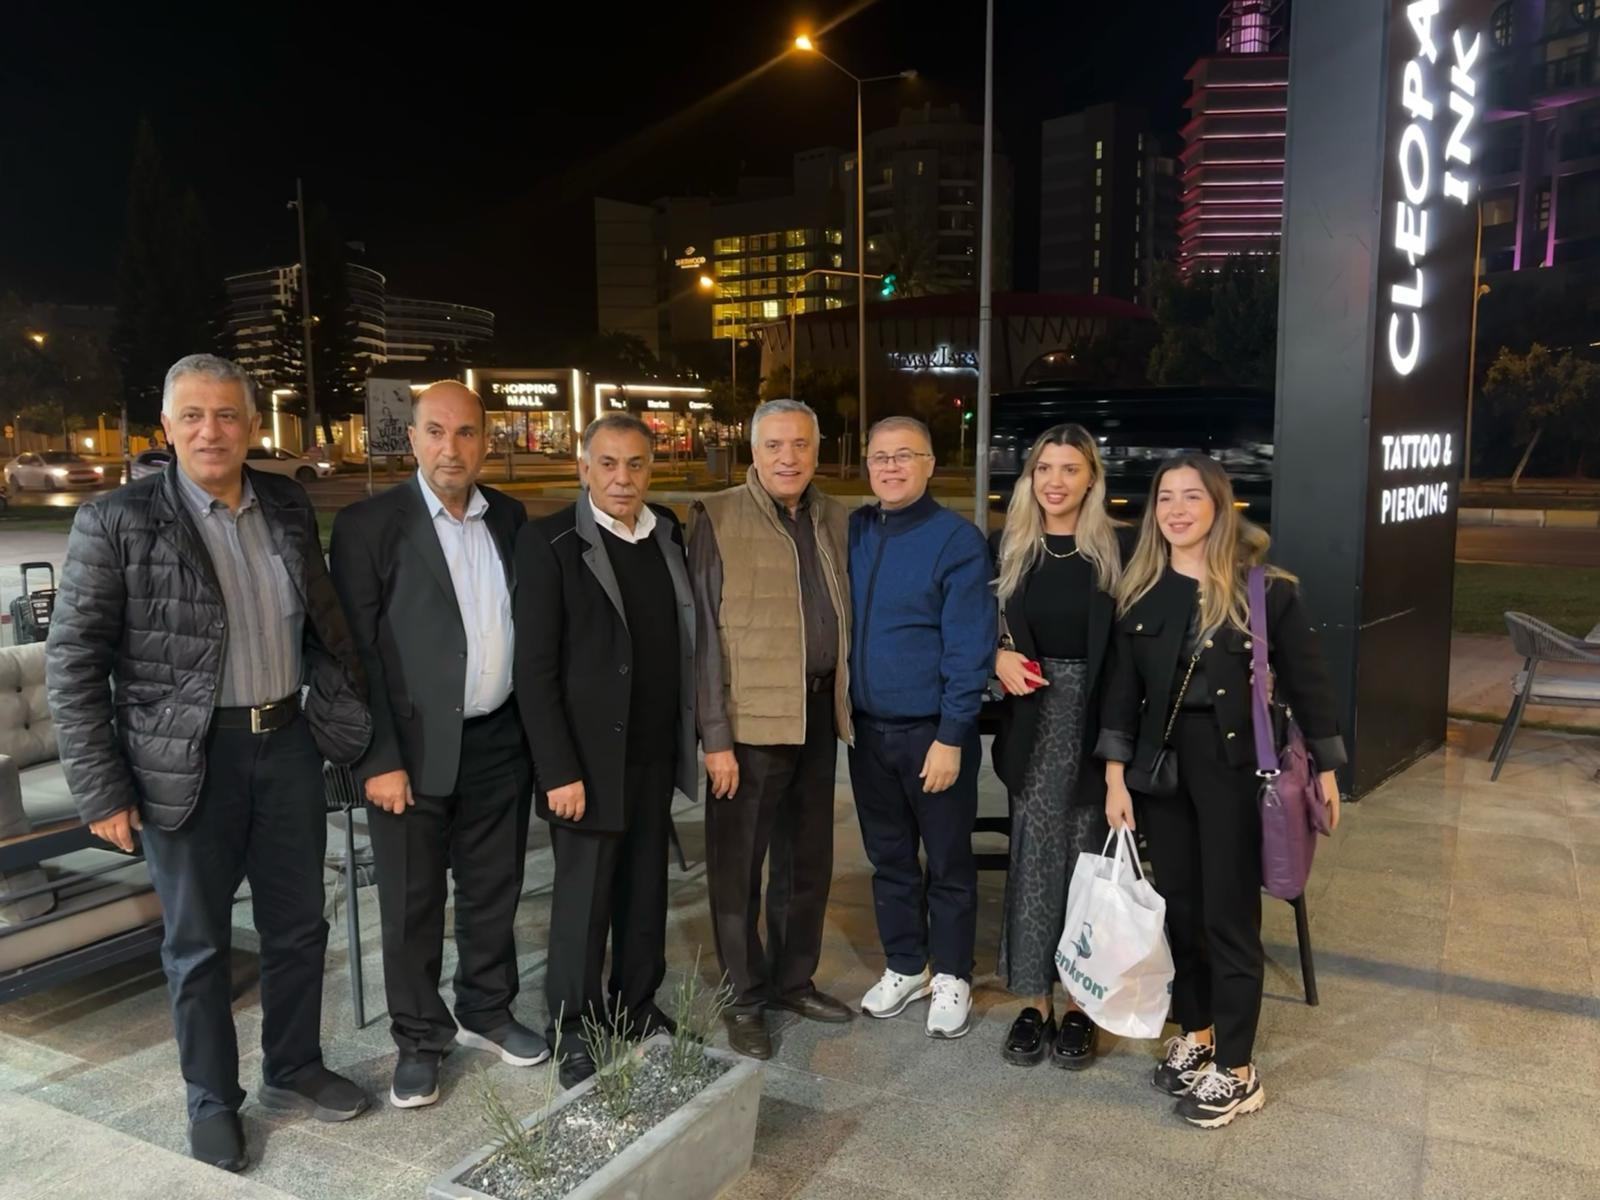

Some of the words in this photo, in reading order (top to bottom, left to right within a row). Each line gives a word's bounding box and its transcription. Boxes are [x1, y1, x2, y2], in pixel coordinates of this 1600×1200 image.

[1443, 28, 1481, 206] INK
[492, 383, 558, 395] SHOPPING
[506, 395, 543, 407] MALL
[1382, 433, 1441, 471] TATTOO
[1442, 433, 1453, 466] &
[1381, 481, 1449, 525] PIERCING
